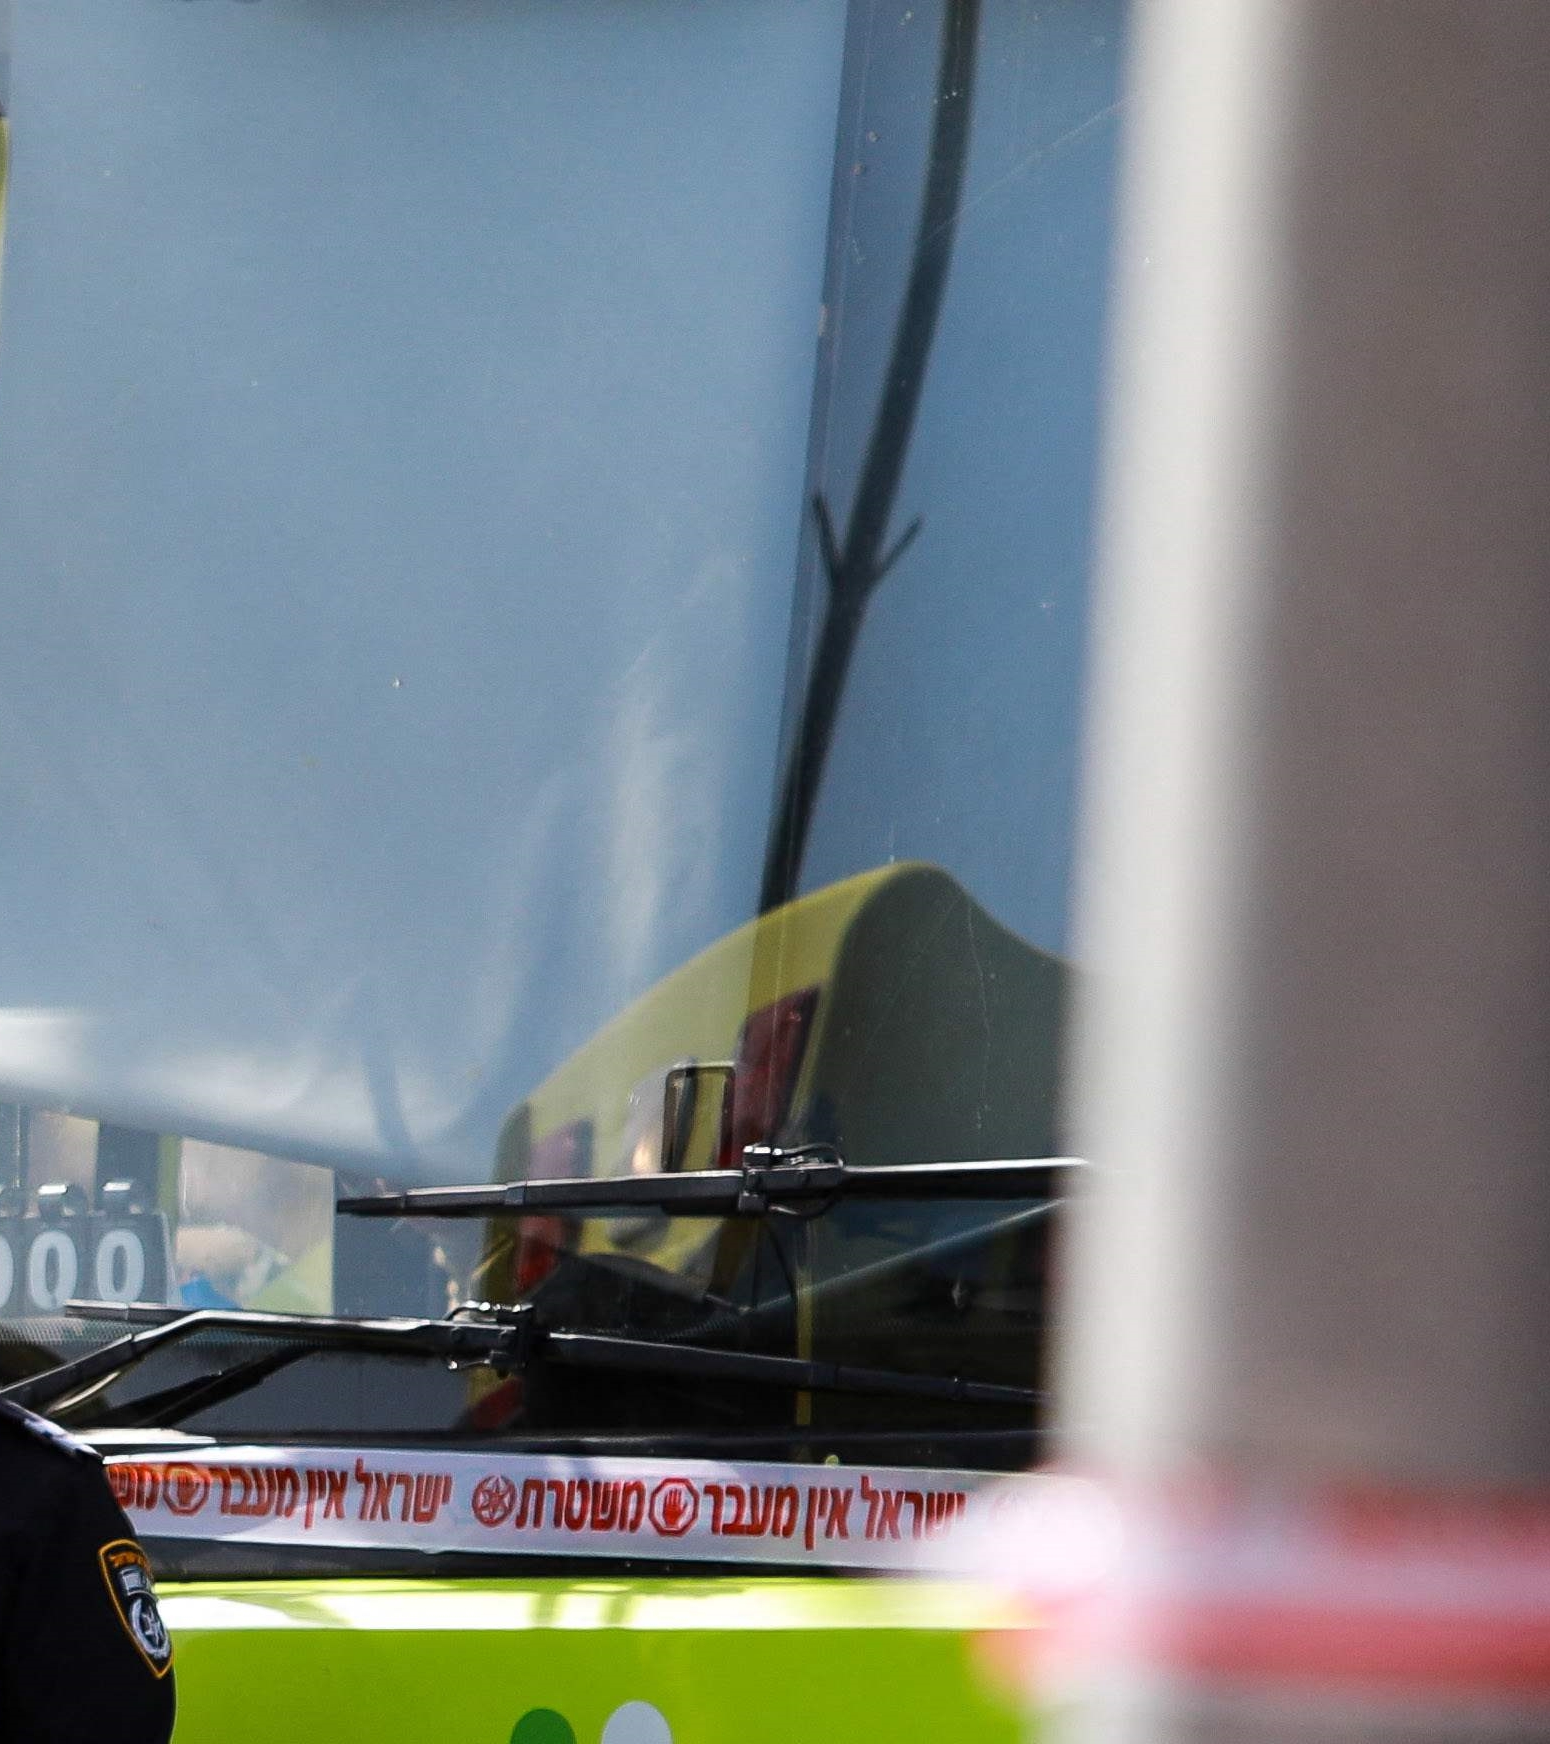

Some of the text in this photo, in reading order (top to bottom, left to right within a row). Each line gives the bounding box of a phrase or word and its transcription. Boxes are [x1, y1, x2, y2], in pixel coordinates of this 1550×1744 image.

[208, 1464, 300, 1519] מעבר
[303, 1467, 349, 1530] אין
[354, 1455, 453, 1526] ישראל
[514, 1475, 648, 1534] משטרת
[702, 1474, 969, 1551] ישראל אין מעבר
